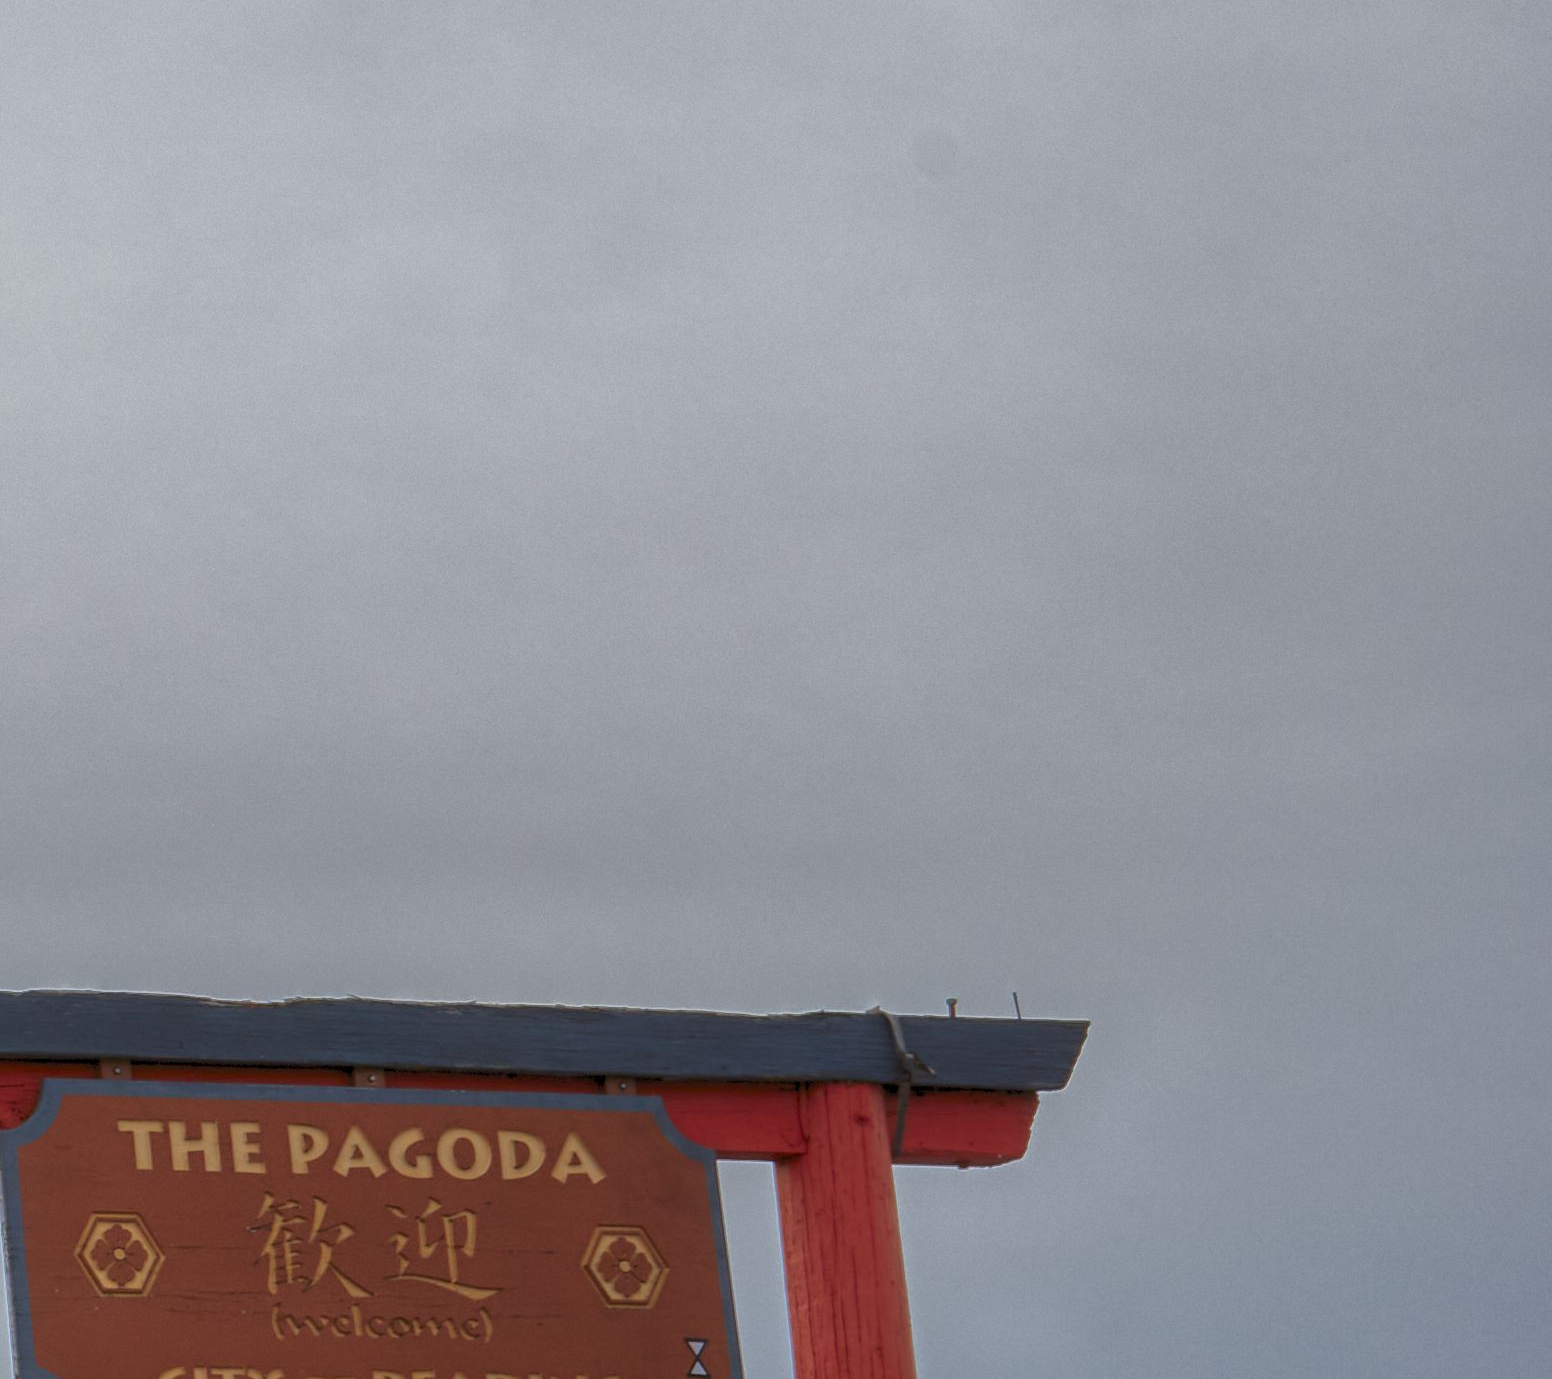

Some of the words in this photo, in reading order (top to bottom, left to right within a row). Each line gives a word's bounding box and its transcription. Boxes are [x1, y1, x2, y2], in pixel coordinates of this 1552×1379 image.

[117, 1120, 267, 1174] THE
[287, 1123, 607, 1184] PAGODA
[271, 1303, 493, 1343] (welcome)
